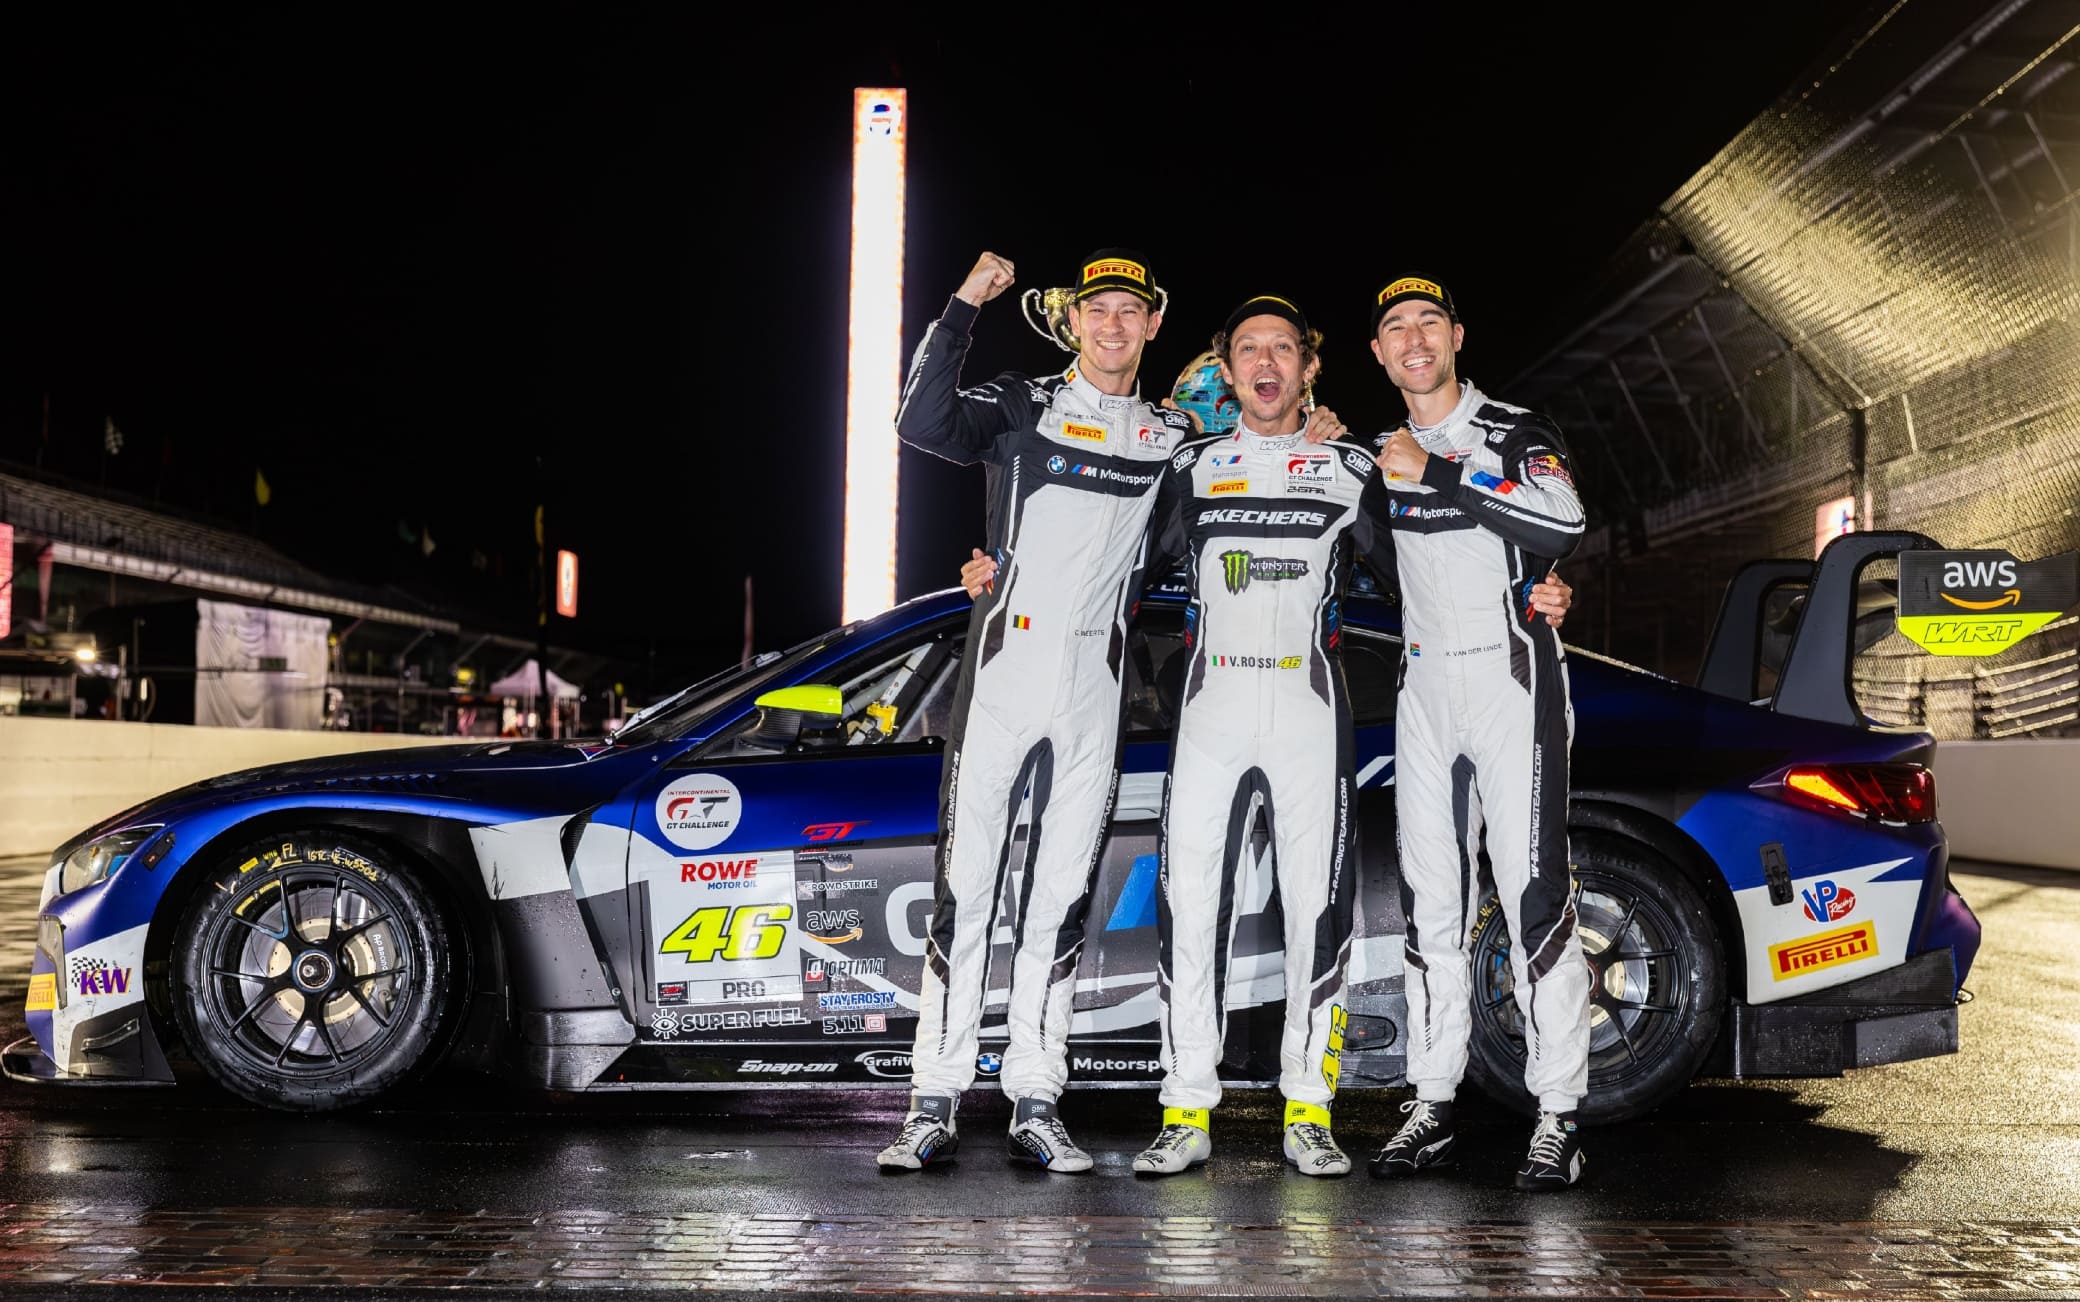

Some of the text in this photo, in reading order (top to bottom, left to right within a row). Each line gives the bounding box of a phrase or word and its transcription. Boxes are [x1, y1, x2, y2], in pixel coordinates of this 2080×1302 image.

[1087, 262, 1143, 279] PIRELLI
[1381, 280, 1437, 301] PIRELLI
[1066, 425, 1102, 440] PIRELLI
[1173, 451, 1196, 471] OMP
[1346, 453, 1373, 473] OMP
[1100, 468, 1156, 485] Motorsport
[1212, 482, 1246, 493] PIRELLI
[1197, 509, 1327, 526] SKECHERS
[1250, 560, 1306, 572] MONSTER
[1943, 560, 2017, 588] aws
[1924, 621, 2022, 643] WRT
[1277, 655, 1302, 669] 46
[1530, 743, 1542, 878] W-RACINGTEAM.COM
[679, 821, 730, 829] CHALLENGE
[282, 843, 297, 857] FL
[1330, 777, 1347, 904] W-RACINGTEAM.COM
[680, 859, 758, 882] ROWE
[708, 882, 741, 890] MOTOR
[1801, 880, 1856, 922] VP Racing
[806, 909, 860, 930] aws
[660, 903, 793, 964] 46
[1778, 929, 1868, 973] PIRELLI
[827, 958, 886, 977] OPTIMA
[80, 967, 132, 996] KW
[722, 980, 766, 999] PRO
[820, 993, 849, 1007] STAY
[851, 991, 896, 1004] FROSTY
[681, 1007, 807, 1032] SUPER FUEL
[823, 1014, 865, 1034] 5.11
[737, 1060, 839, 1075] Snap-on
